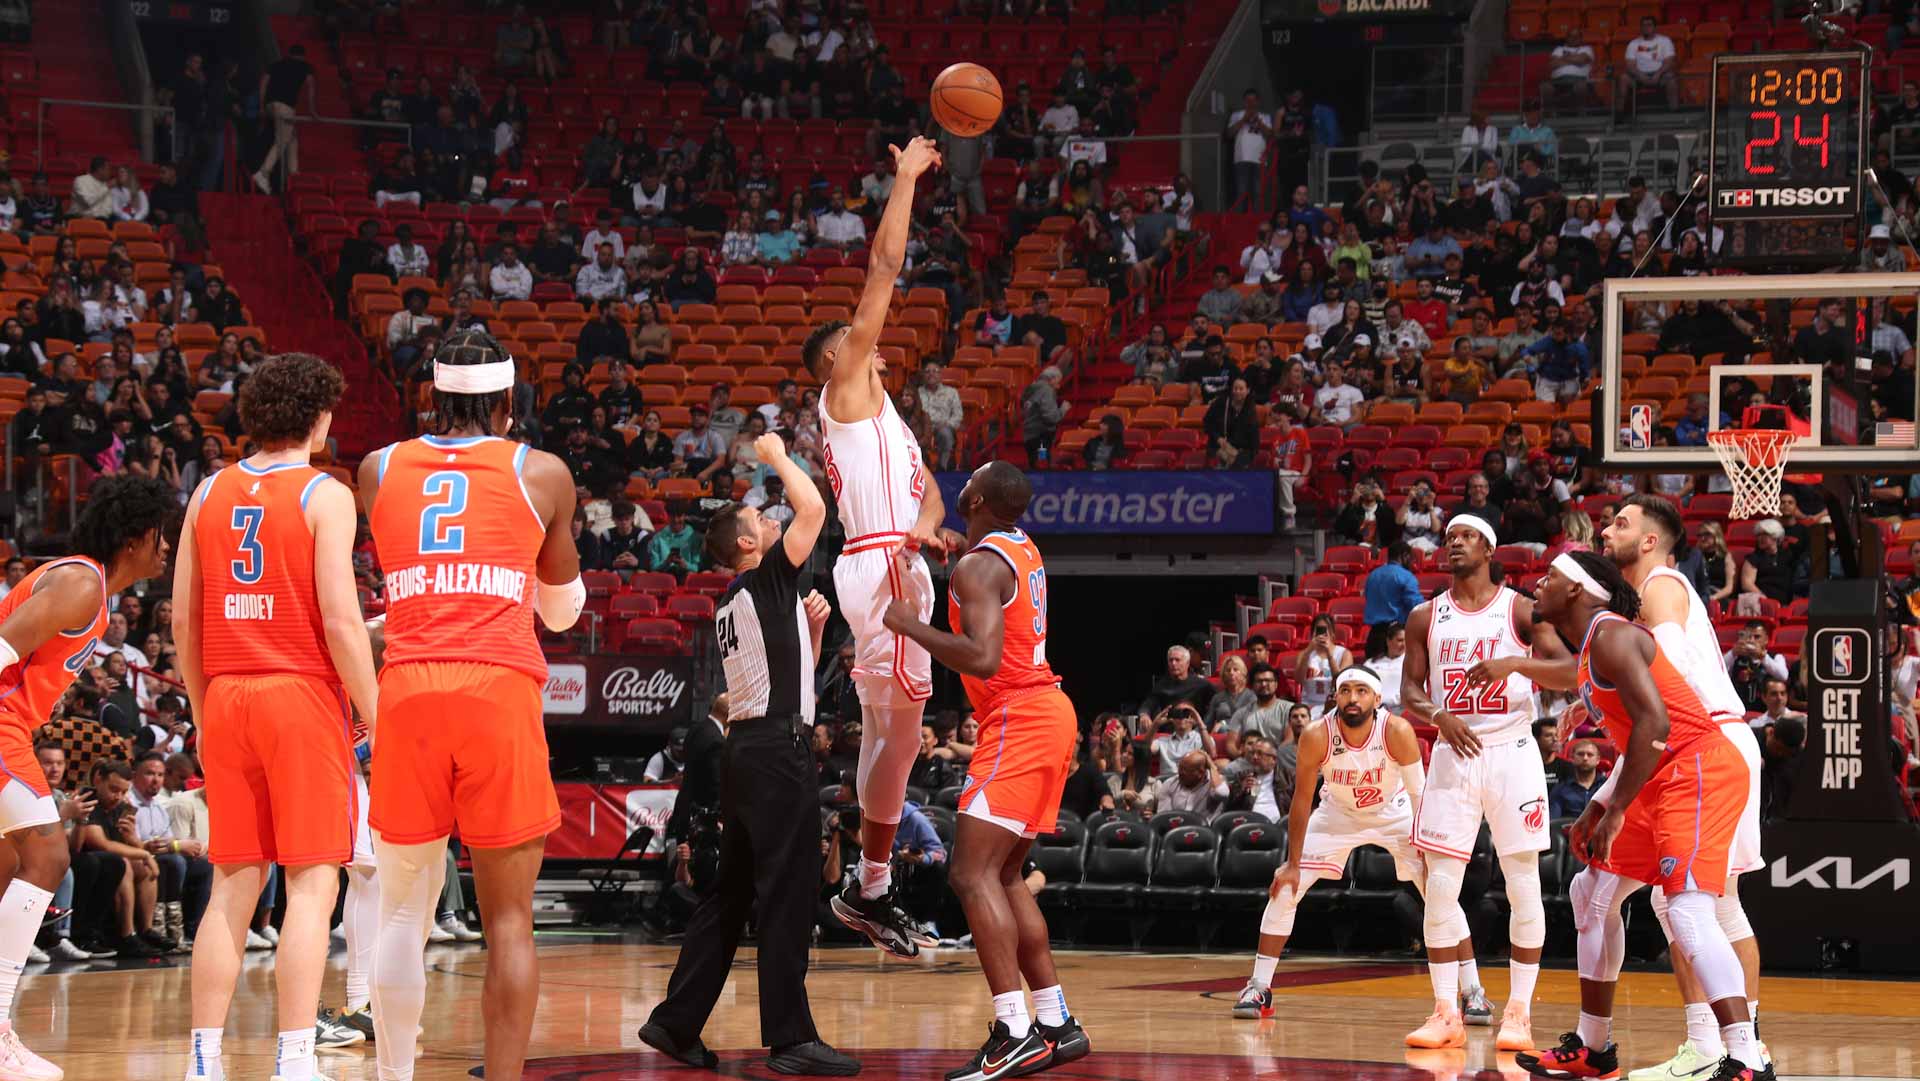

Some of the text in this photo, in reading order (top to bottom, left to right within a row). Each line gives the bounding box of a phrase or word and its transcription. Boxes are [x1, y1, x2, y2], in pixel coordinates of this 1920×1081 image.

[1750, 67, 1843, 106] 12:00
[1744, 110, 1830, 175] 24
[1754, 186, 1851, 207] TISSOT
[418, 470, 469, 555] 2
[231, 505, 265, 584] 3
[224, 593, 275, 621] GIDDEY
[718, 611, 739, 659] 24
[1438, 628, 1503, 665] HEAT
[544, 676, 584, 697] Bally
[602, 666, 686, 708] Bally
[1443, 668, 1508, 715] 22
[608, 700, 664, 715] SPORTS+
[1822, 688, 1861, 721] GET
[1822, 723, 1862, 755] THE
[1331, 758, 1386, 787] HEAT
[1821, 757, 1862, 790] APP
[1352, 786, 1384, 809] 2
[1771, 856, 1910, 891] KIA
